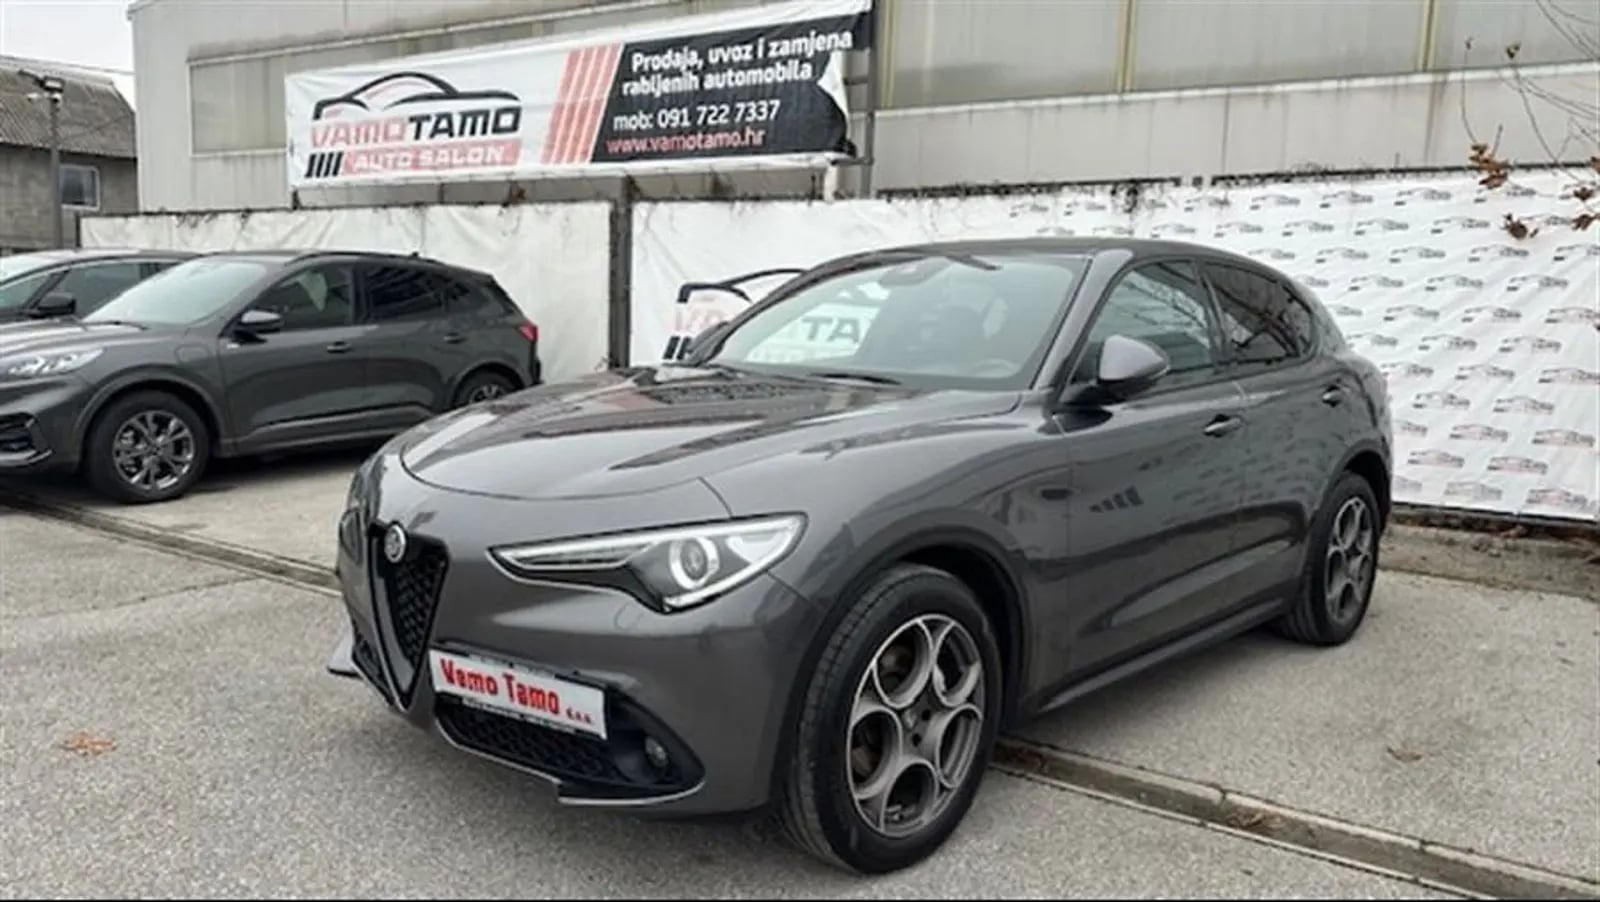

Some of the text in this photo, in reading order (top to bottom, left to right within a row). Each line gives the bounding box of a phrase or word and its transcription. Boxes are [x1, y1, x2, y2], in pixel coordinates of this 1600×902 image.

[631, 30, 853, 73] Prodaja, uvoz i zamjena
[622, 58, 813, 97] rabljenih automobila
[613, 99, 781, 131] mob: 091 722 7337
[606, 126, 766, 154] www.vamotamo.hr
[353, 145, 506, 170] AUTO SALON
